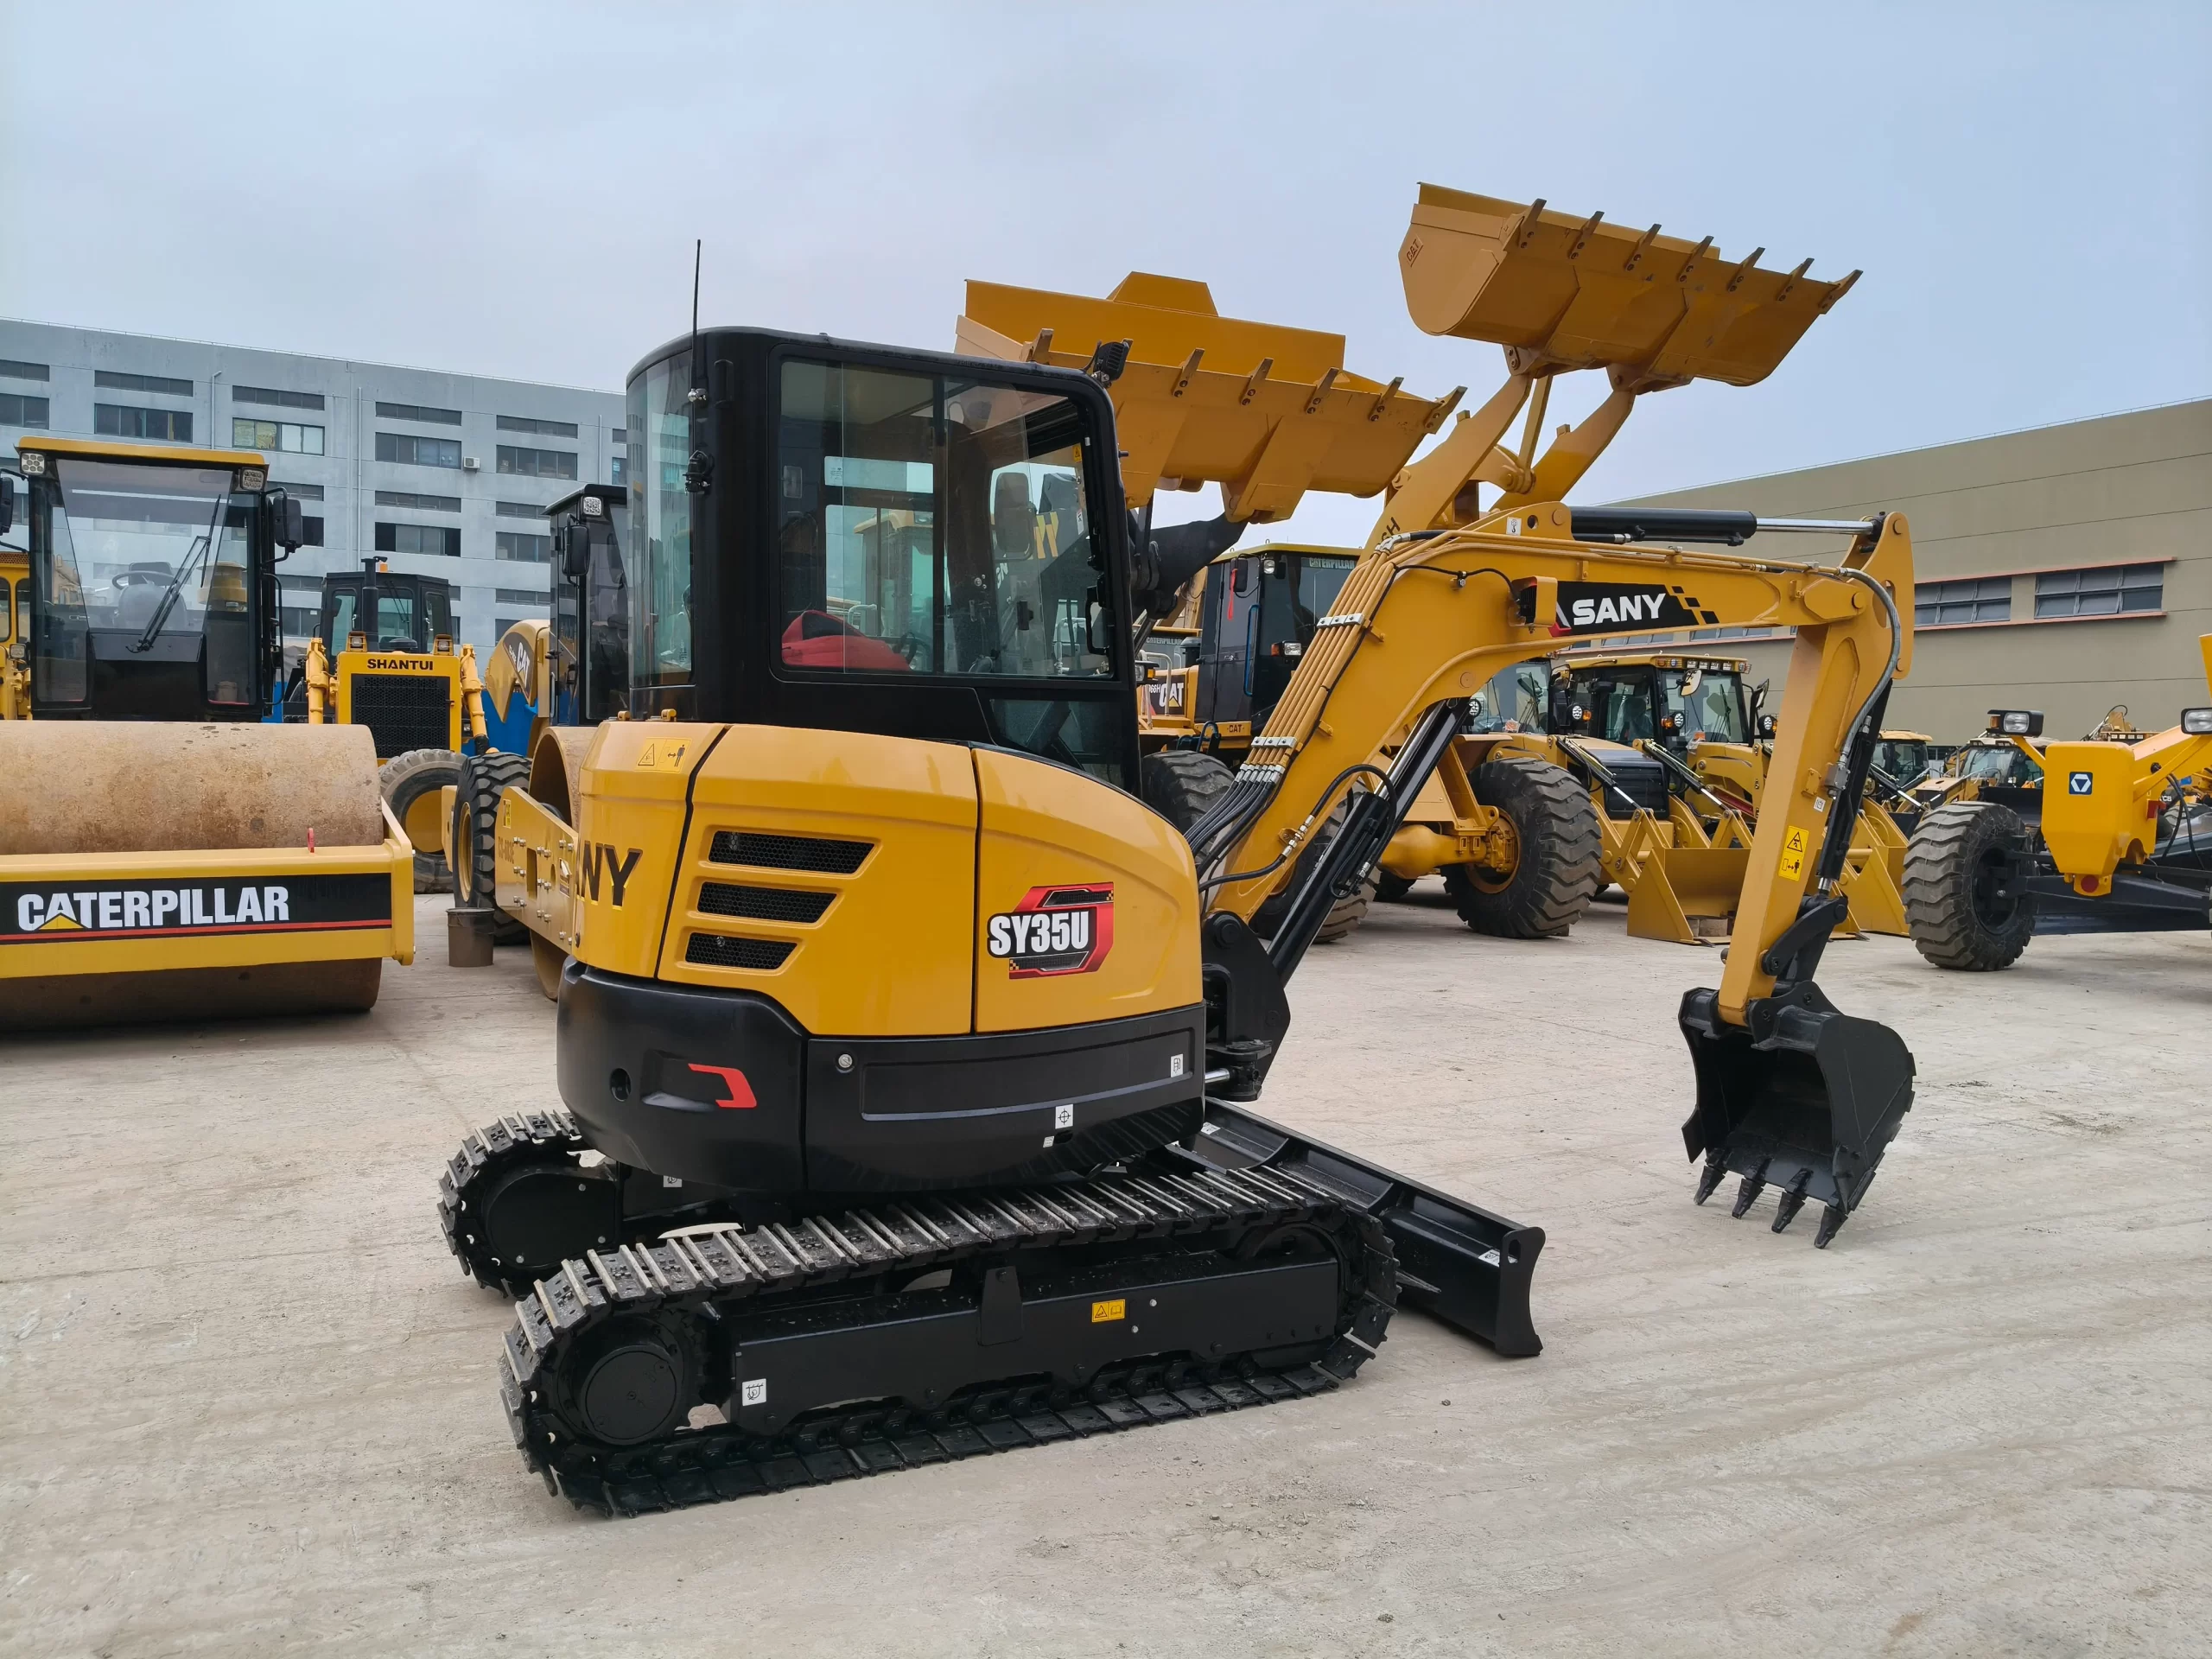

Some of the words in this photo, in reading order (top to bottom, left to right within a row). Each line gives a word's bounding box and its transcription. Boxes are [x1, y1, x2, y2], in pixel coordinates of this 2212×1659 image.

[1309, 557, 1355, 569] CATERPILLAR
[1572, 593, 1666, 626] SANY
[367, 658, 434, 671] SHANTUI
[517, 642, 531, 689] CAT
[1159, 682, 1185, 708] CAT
[1229, 724, 1243, 733] CAT
[576, 840, 644, 907] NY
[17, 887, 289, 931] CATERPILLAR
[989, 911, 1090, 956] SY35U
